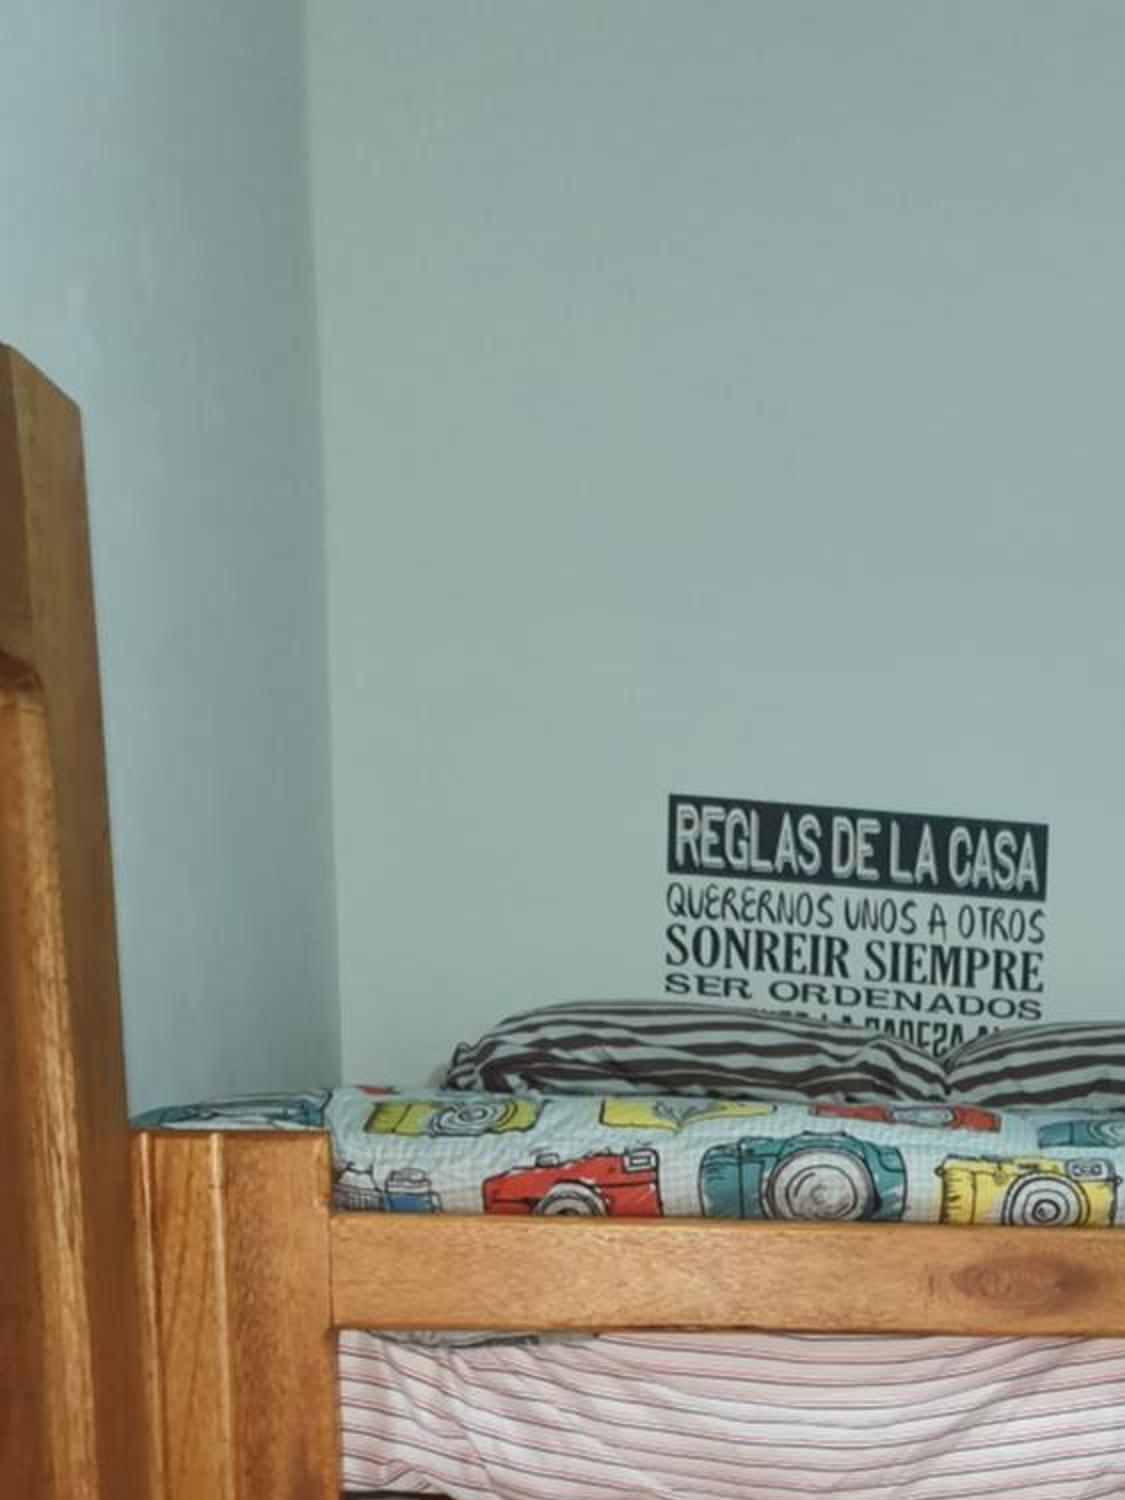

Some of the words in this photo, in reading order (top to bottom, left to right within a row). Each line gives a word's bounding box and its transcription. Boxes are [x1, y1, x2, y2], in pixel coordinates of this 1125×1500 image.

[675, 803, 822, 876] REGLAS
[831, 816, 881, 881] DE
[889, 820, 938, 885] LA
[948, 826, 1039, 893] CASA
[667, 882, 834, 929] QUERERNOS
[844, 897, 918, 934] UNOS
[928, 903, 947, 942] A
[957, 903, 1045, 945] OTROS
[665, 923, 849, 979] SONREIR
[864, 940, 1044, 993] SIEMPRE
[664, 973, 753, 1003] SER
[768, 980, 1043, 1021] ORDENADOS
